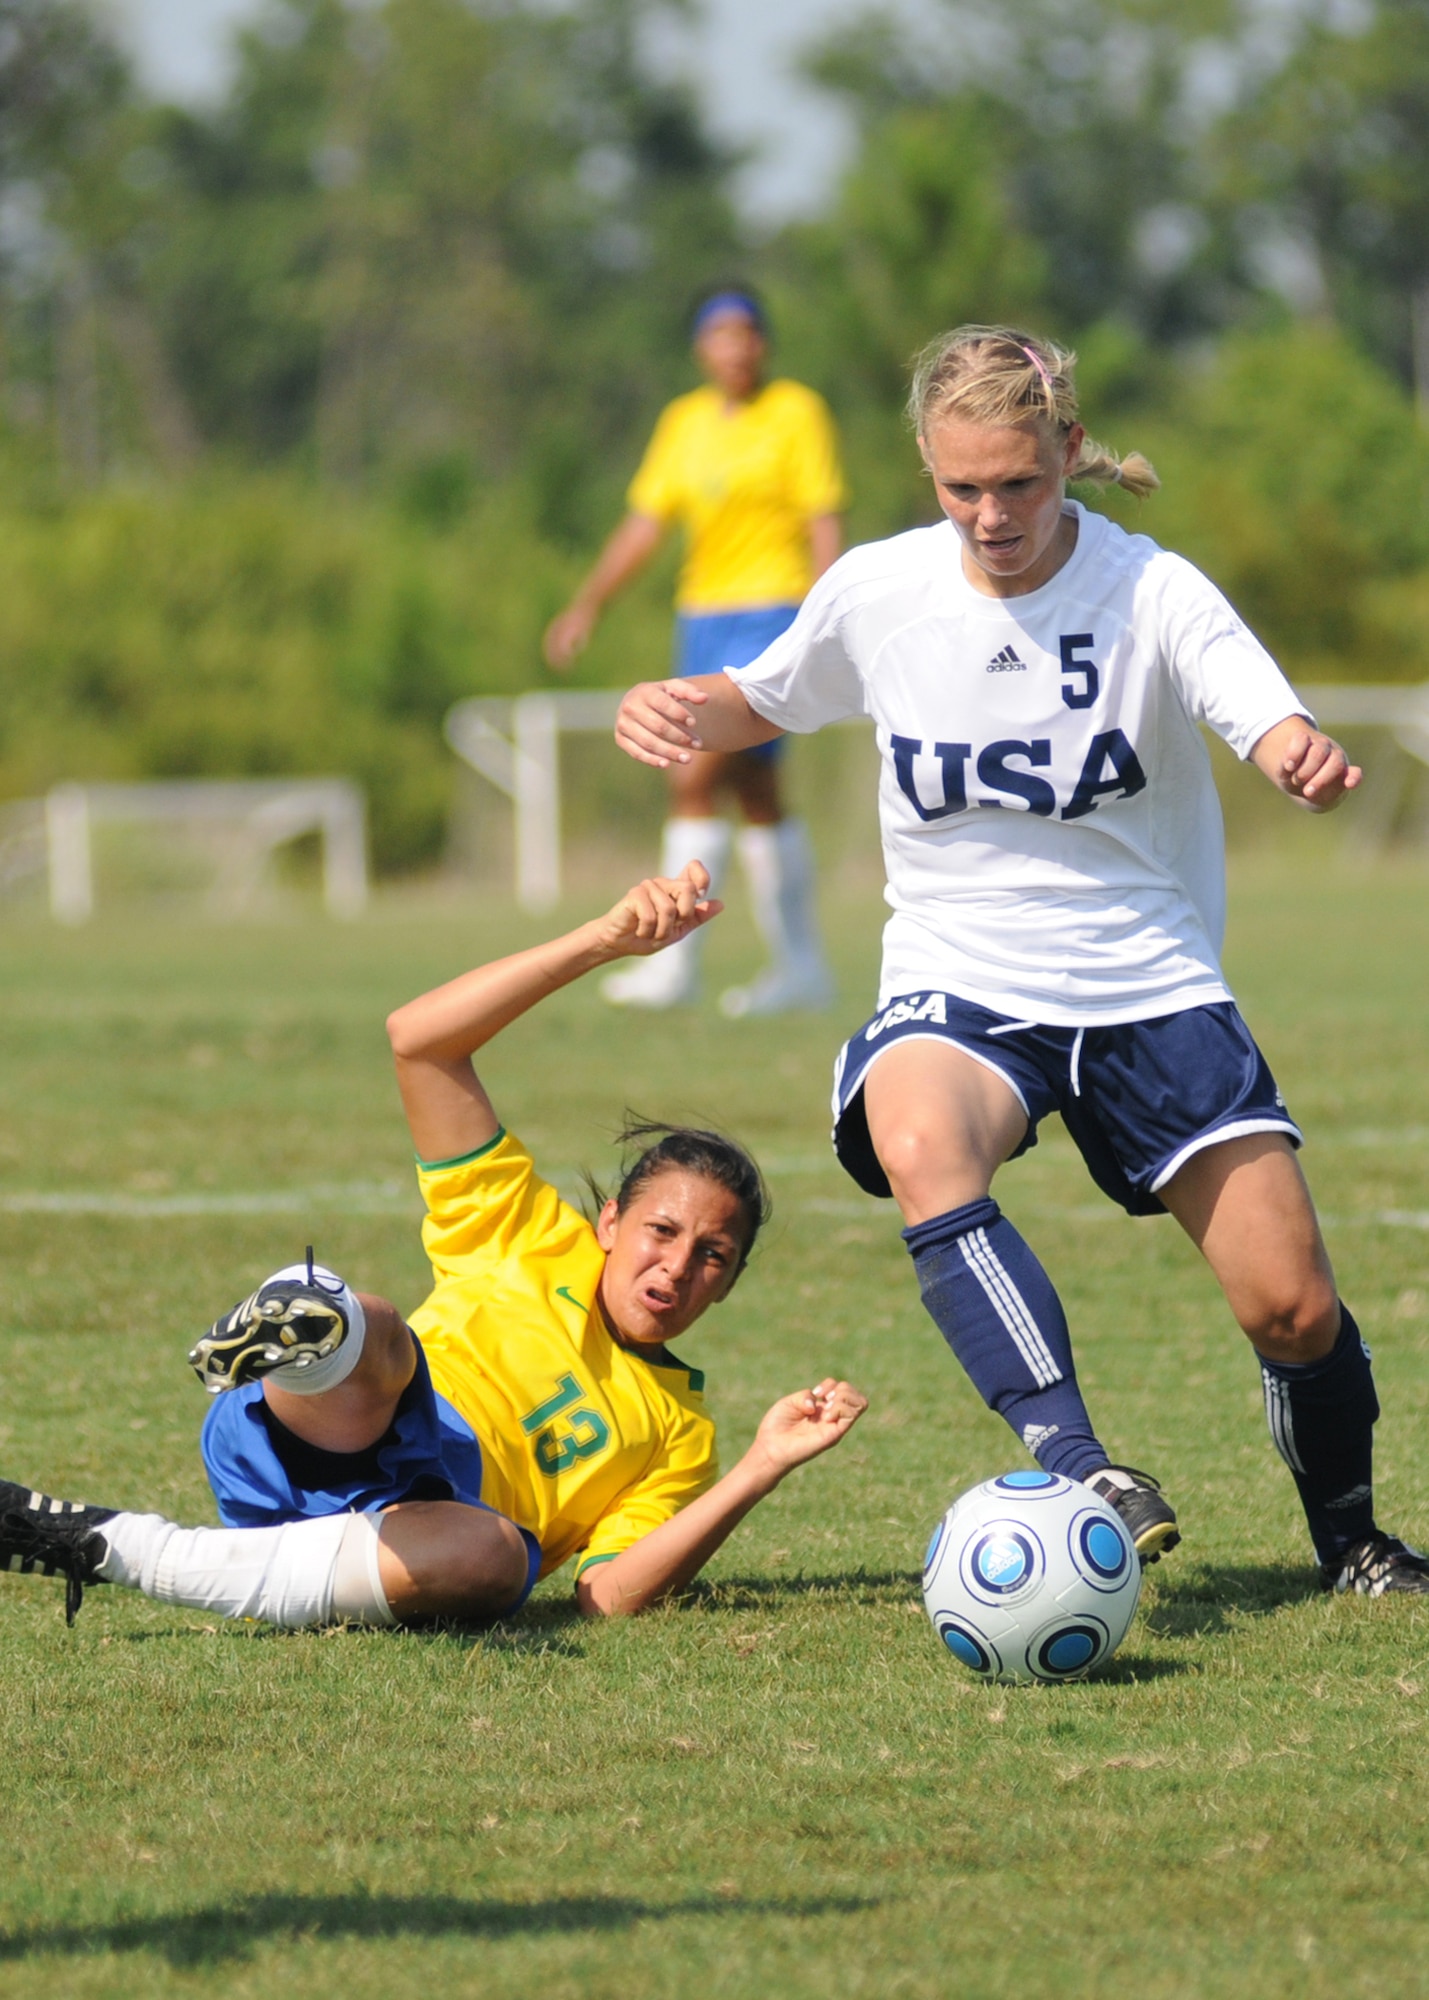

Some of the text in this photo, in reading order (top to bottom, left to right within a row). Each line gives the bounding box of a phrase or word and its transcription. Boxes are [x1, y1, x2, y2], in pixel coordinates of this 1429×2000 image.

[986, 662, 1028, 673] adidas
[1059, 633, 1099, 710] 5
[890, 728, 1147, 821] USA
[865, 993, 947, 1041] USA
[519, 1371, 612, 1479] 13
[986, 1552, 1022, 1581] adidas
